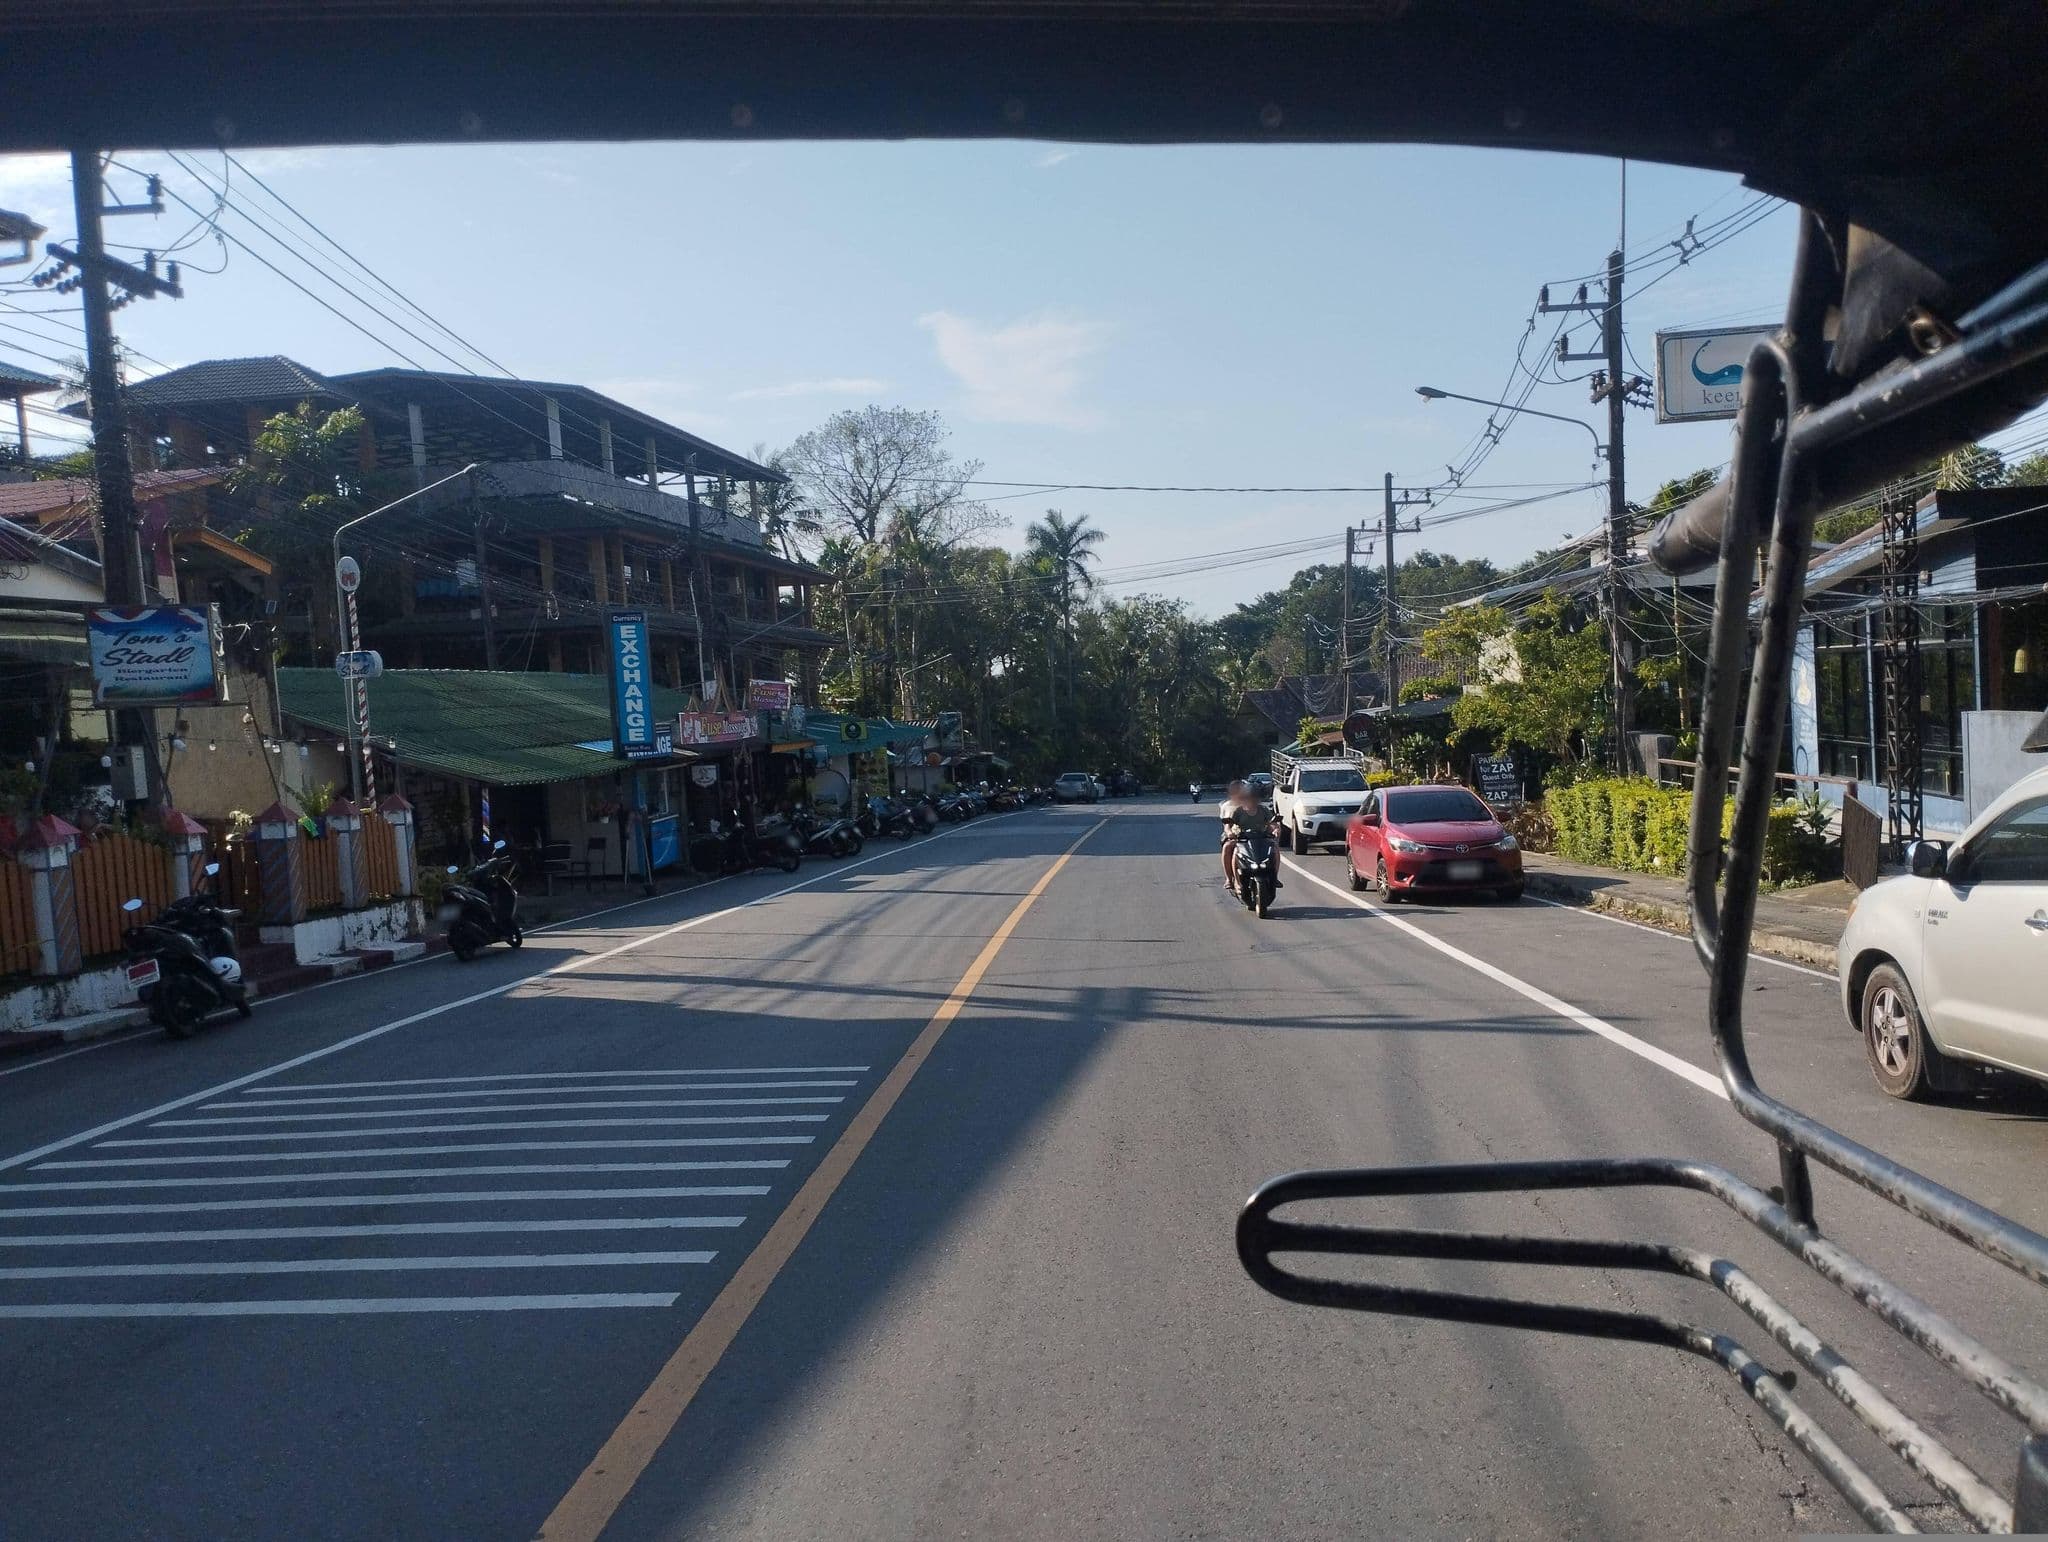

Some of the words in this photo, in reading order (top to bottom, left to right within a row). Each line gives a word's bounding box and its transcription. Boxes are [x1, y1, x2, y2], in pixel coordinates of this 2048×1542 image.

[100, 647, 195, 666] Stadl
[619, 625, 646, 742] EXCHANGE
[700, 717, 722, 736] Fuse
[1491, 763, 1514, 774] ZAP
[1486, 791, 1508, 801] ZAP
